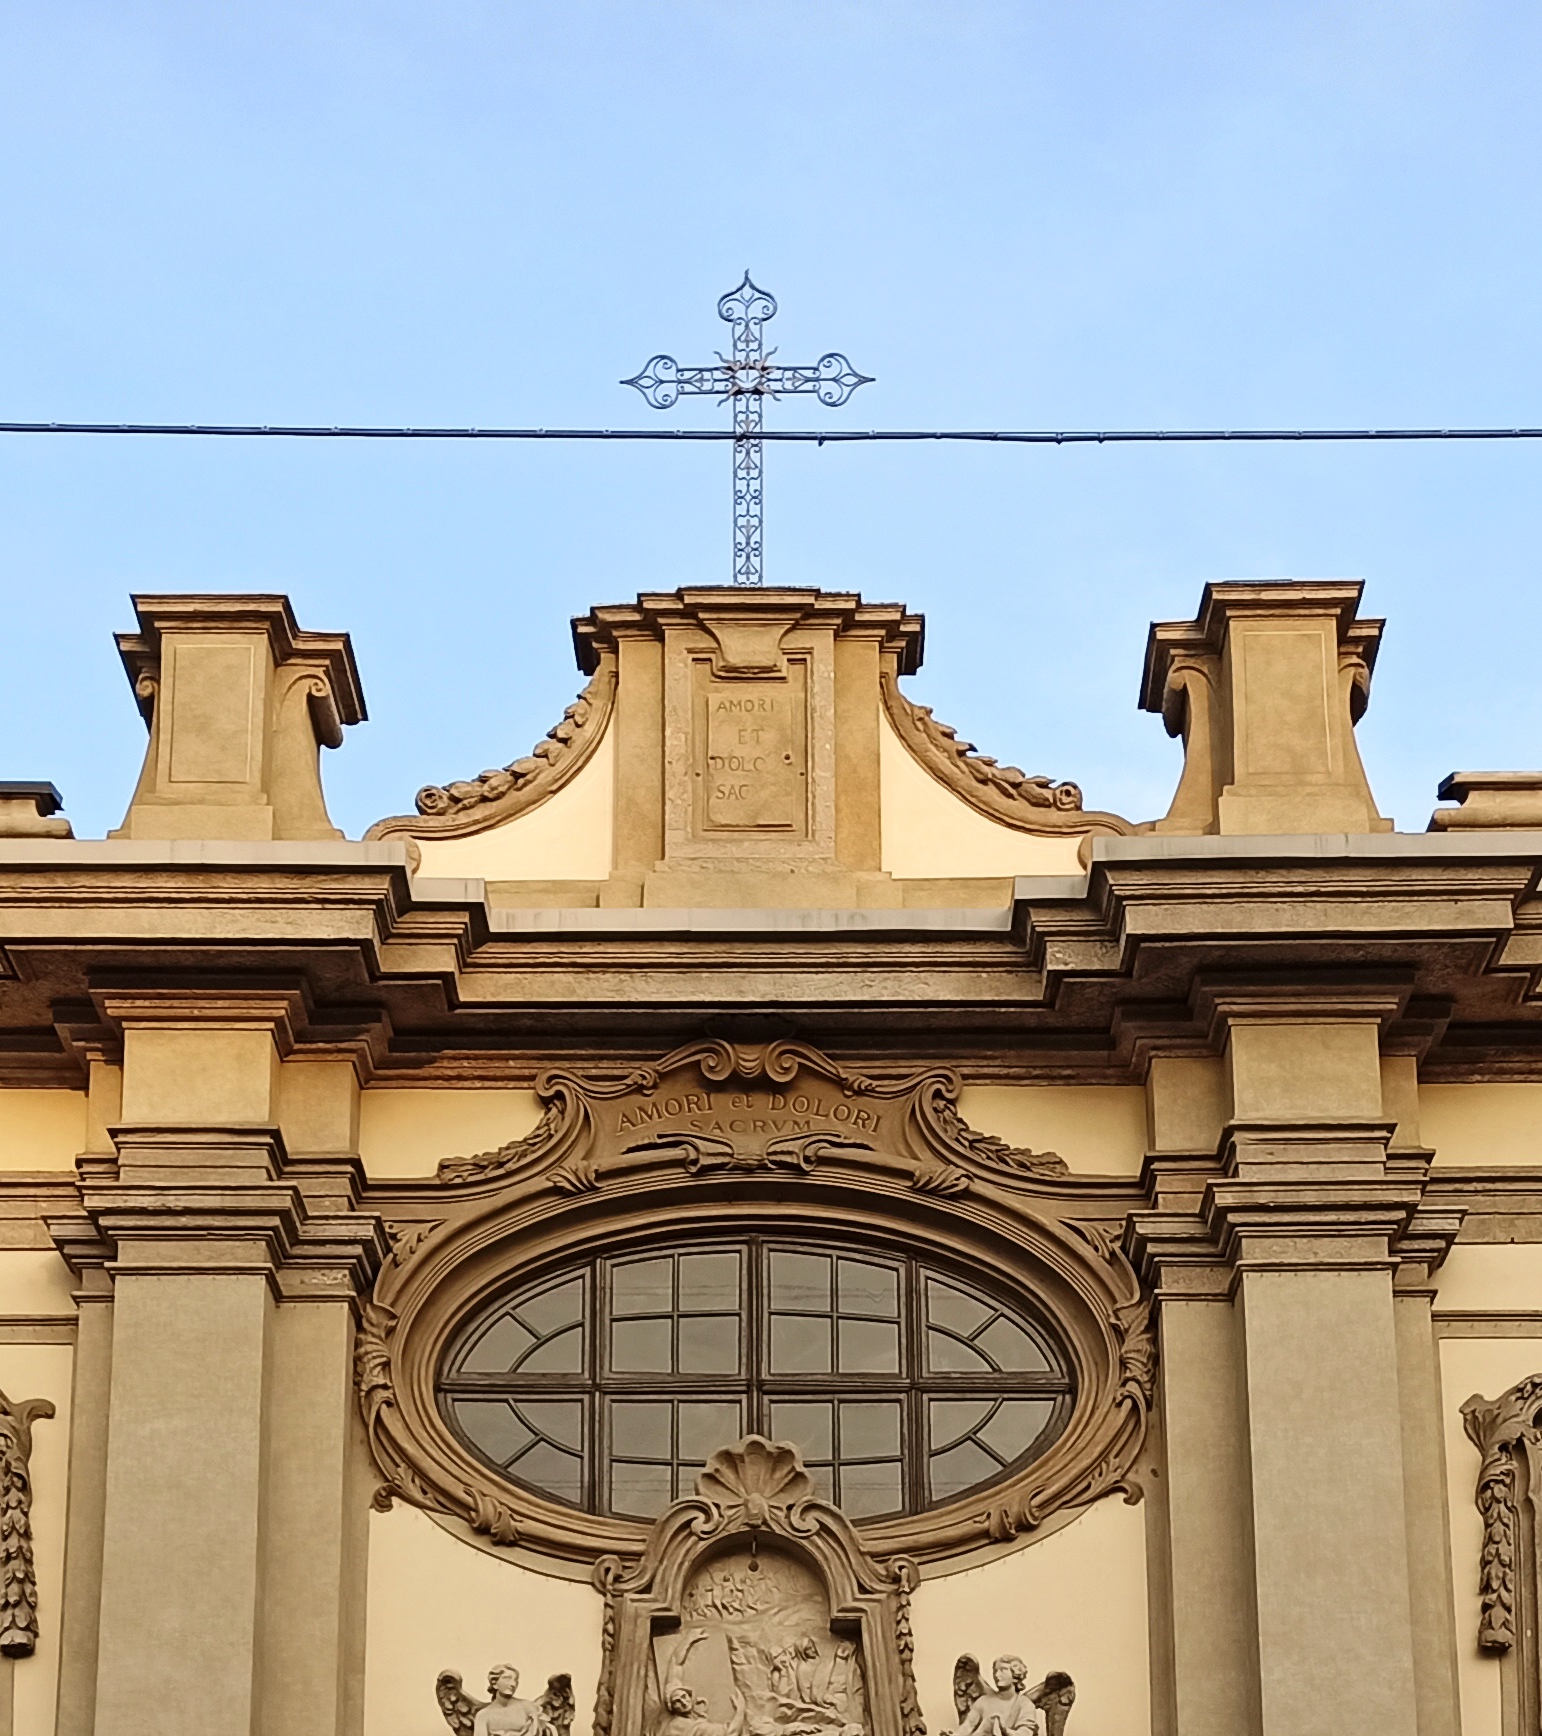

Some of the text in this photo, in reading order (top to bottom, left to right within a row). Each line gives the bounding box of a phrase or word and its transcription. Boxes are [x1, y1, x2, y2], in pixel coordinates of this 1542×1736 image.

[716, 699, 774, 713] AMORI
[738, 729, 765, 745] ET
[616, 1092, 881, 1134] AMORI et DOLORI
[688, 1118, 812, 1133] SACRVM
